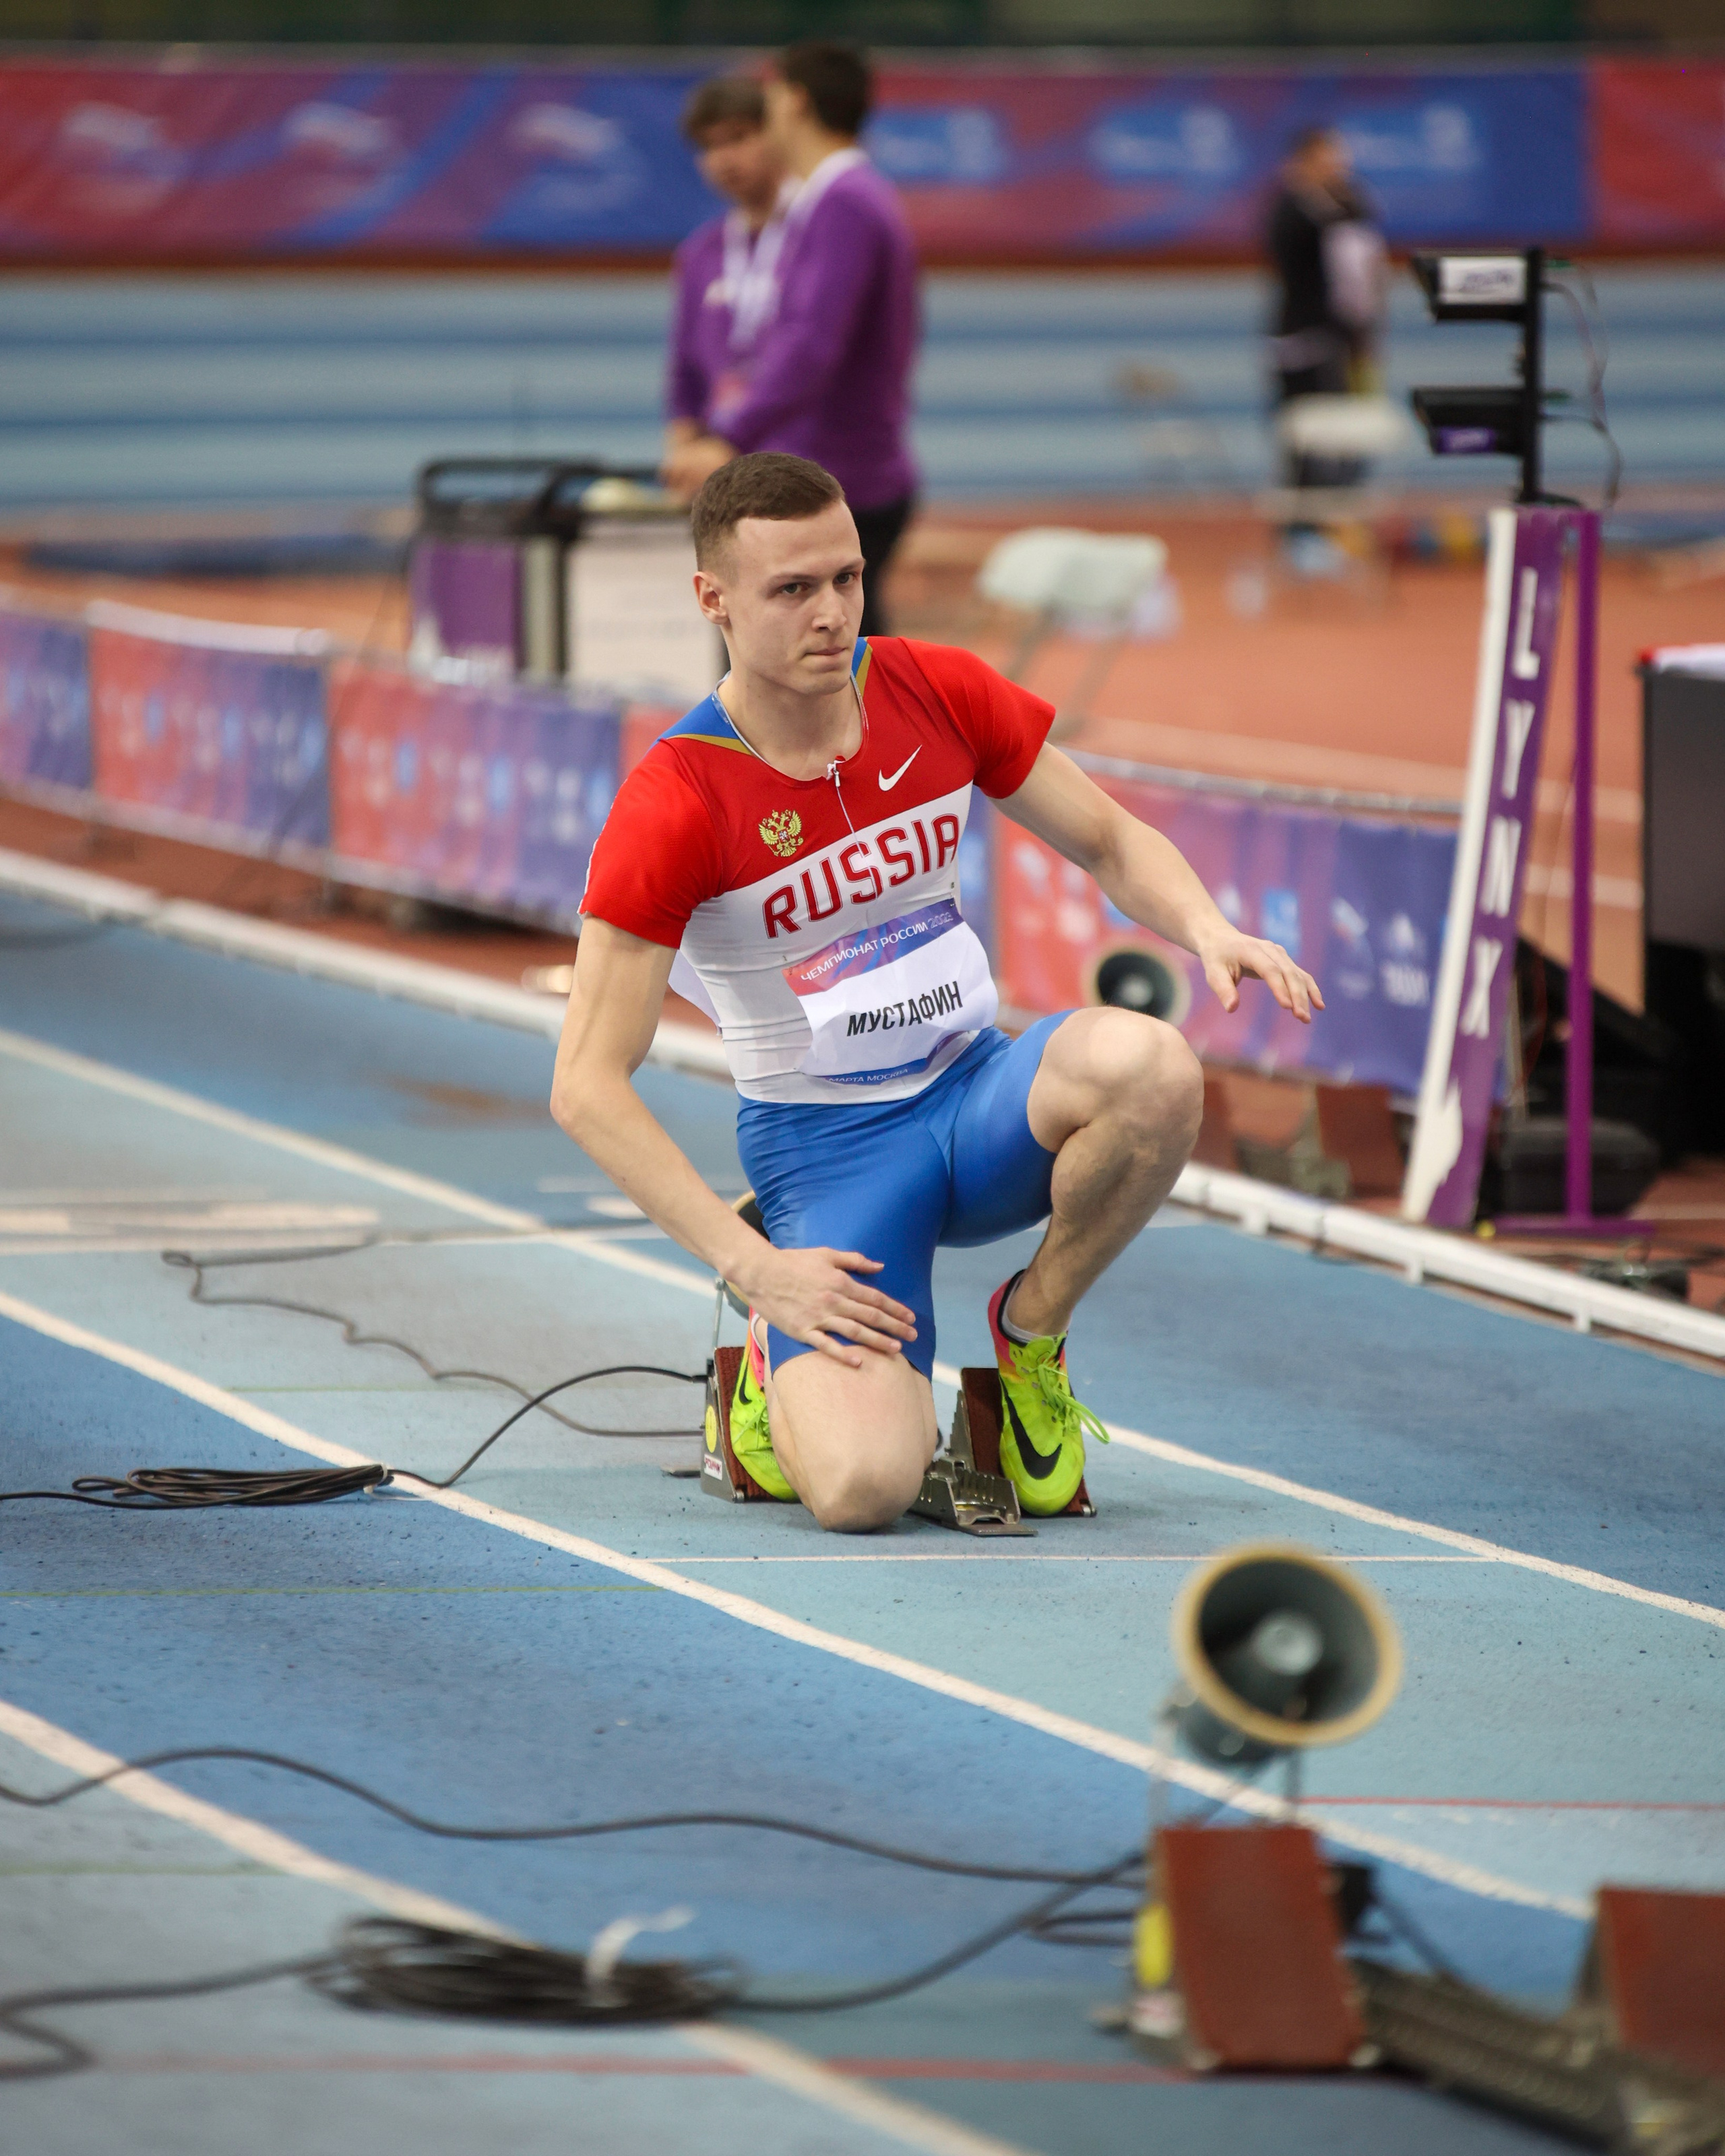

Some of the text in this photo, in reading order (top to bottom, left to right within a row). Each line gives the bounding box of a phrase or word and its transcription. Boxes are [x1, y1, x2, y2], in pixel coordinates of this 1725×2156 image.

[1460, 566, 1540, 1038] LYNX
[762, 813, 960, 939] RUSSIA
[801, 940, 878, 981] ЧЕМПИОНАТ
[880, 921, 929, 948] РОССИИ
[846, 980, 964, 1037] МУСТАФИН
[867, 1069, 908, 1082] МОСКВА
